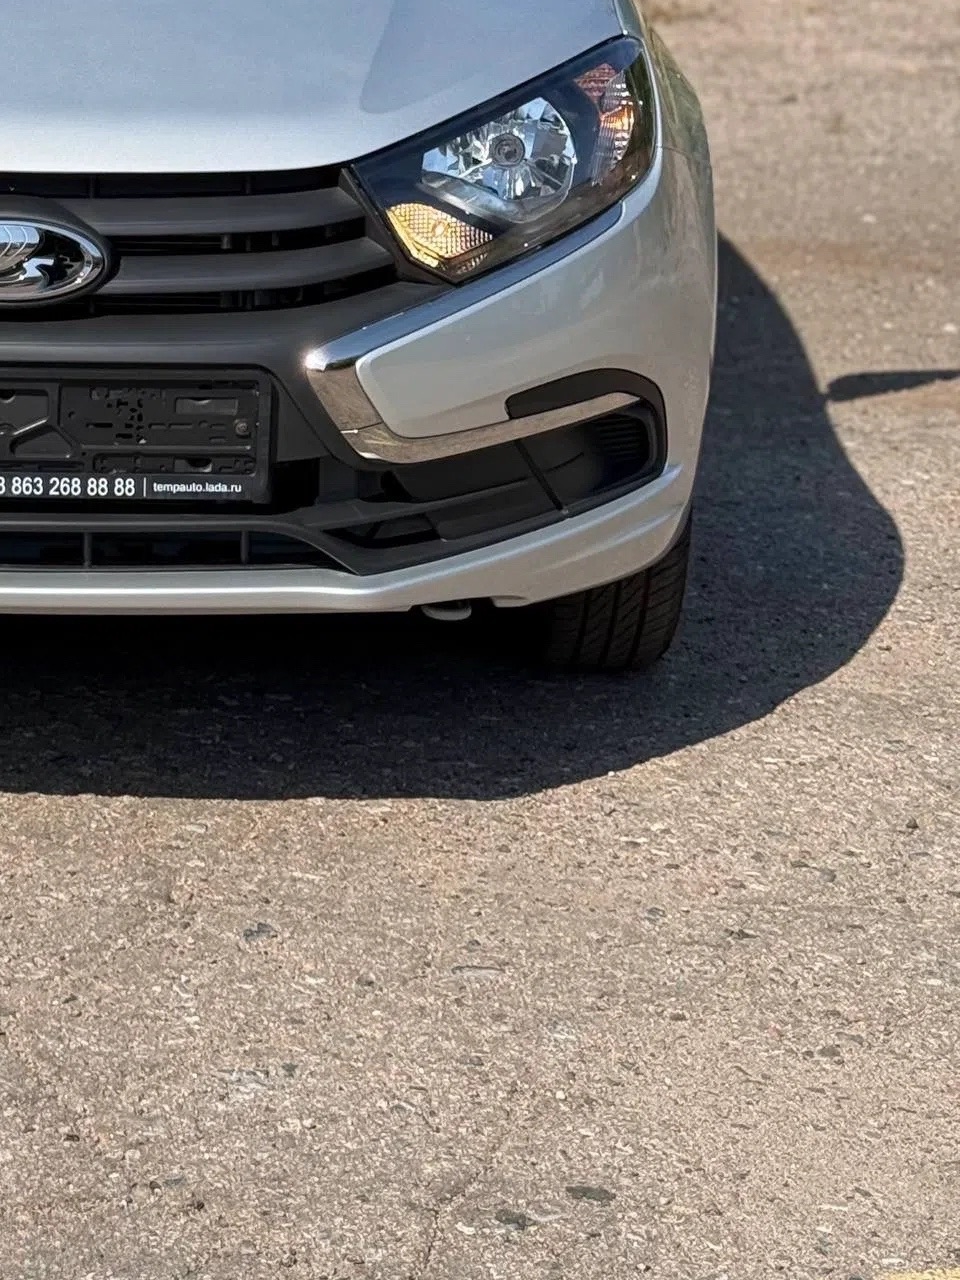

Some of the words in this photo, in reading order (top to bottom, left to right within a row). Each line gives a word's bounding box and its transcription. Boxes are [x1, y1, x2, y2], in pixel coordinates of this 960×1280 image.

[10, 476, 44, 496] 863
[48, 476, 82, 497] 268
[86, 477, 109, 497] 88
[113, 477, 136, 497] 88
[152, 480, 242, 495] tempauto.lada.ru
